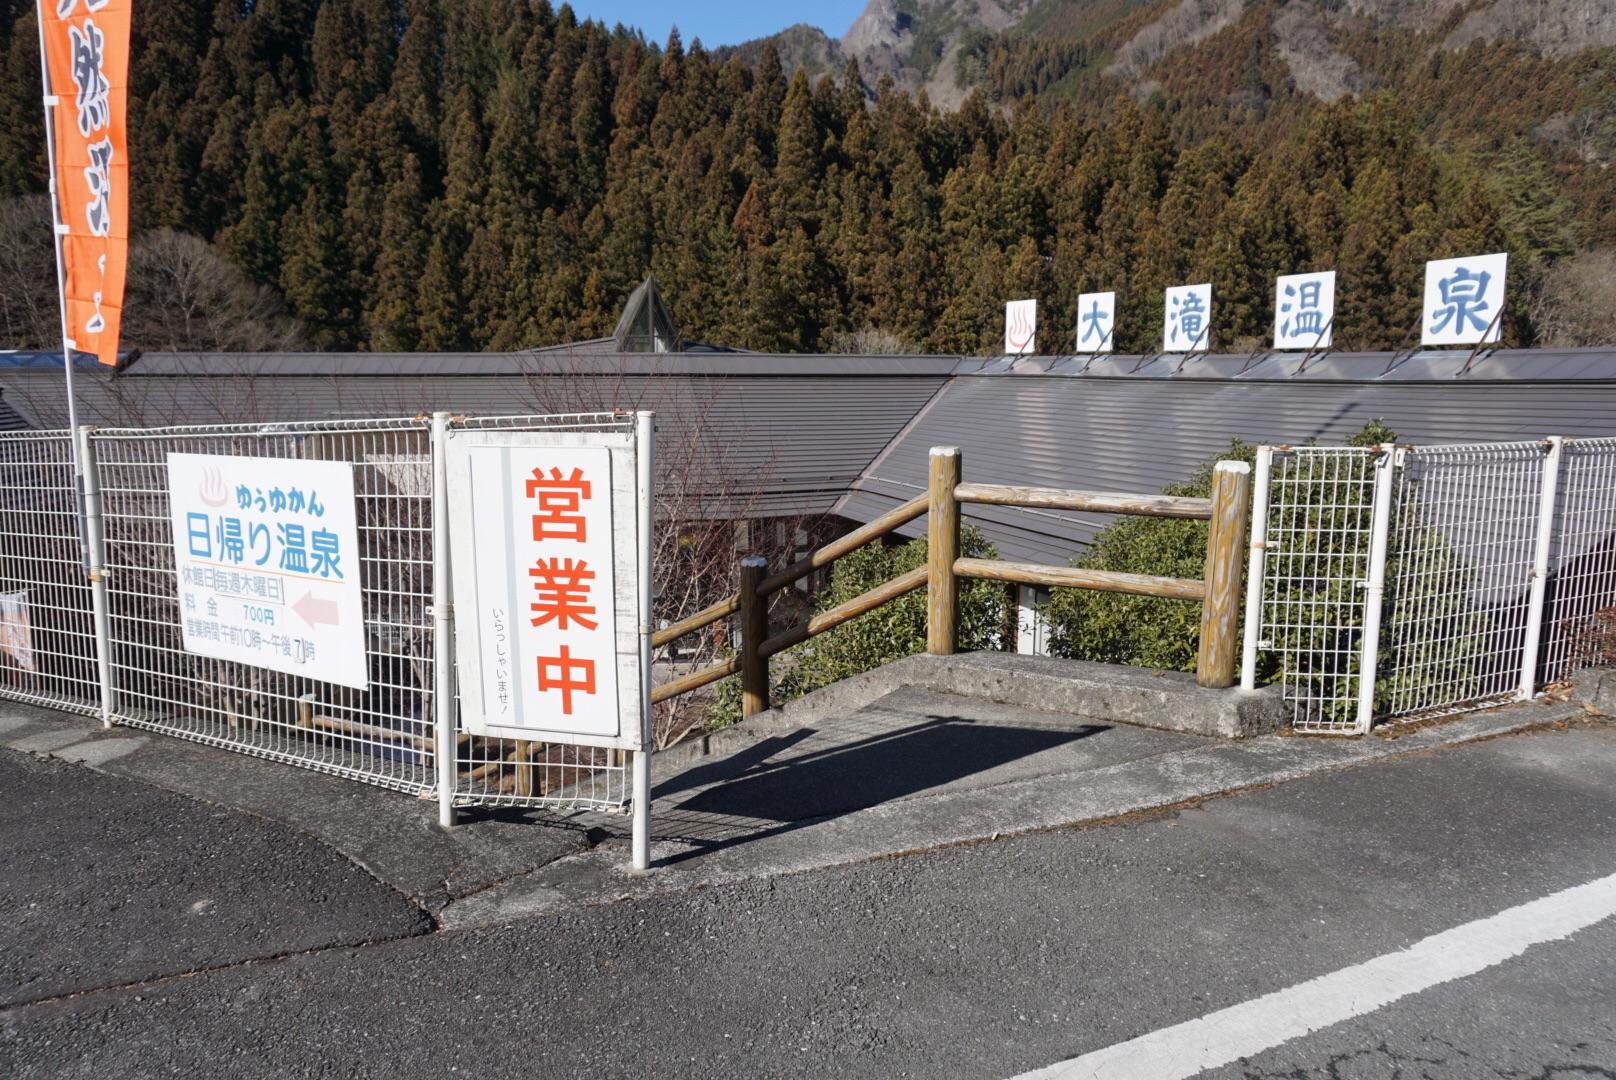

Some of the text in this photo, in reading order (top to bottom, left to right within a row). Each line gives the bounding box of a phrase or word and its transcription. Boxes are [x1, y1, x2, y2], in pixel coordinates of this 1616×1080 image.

[1081, 266, 1491, 343] 大滝温泉
[235, 484, 325, 517] ゆうゆかん
[186, 511, 344, 579] 日帰り温泉
[242, 604, 275, 626] 700円
[525, 466, 599, 715] 営業中
